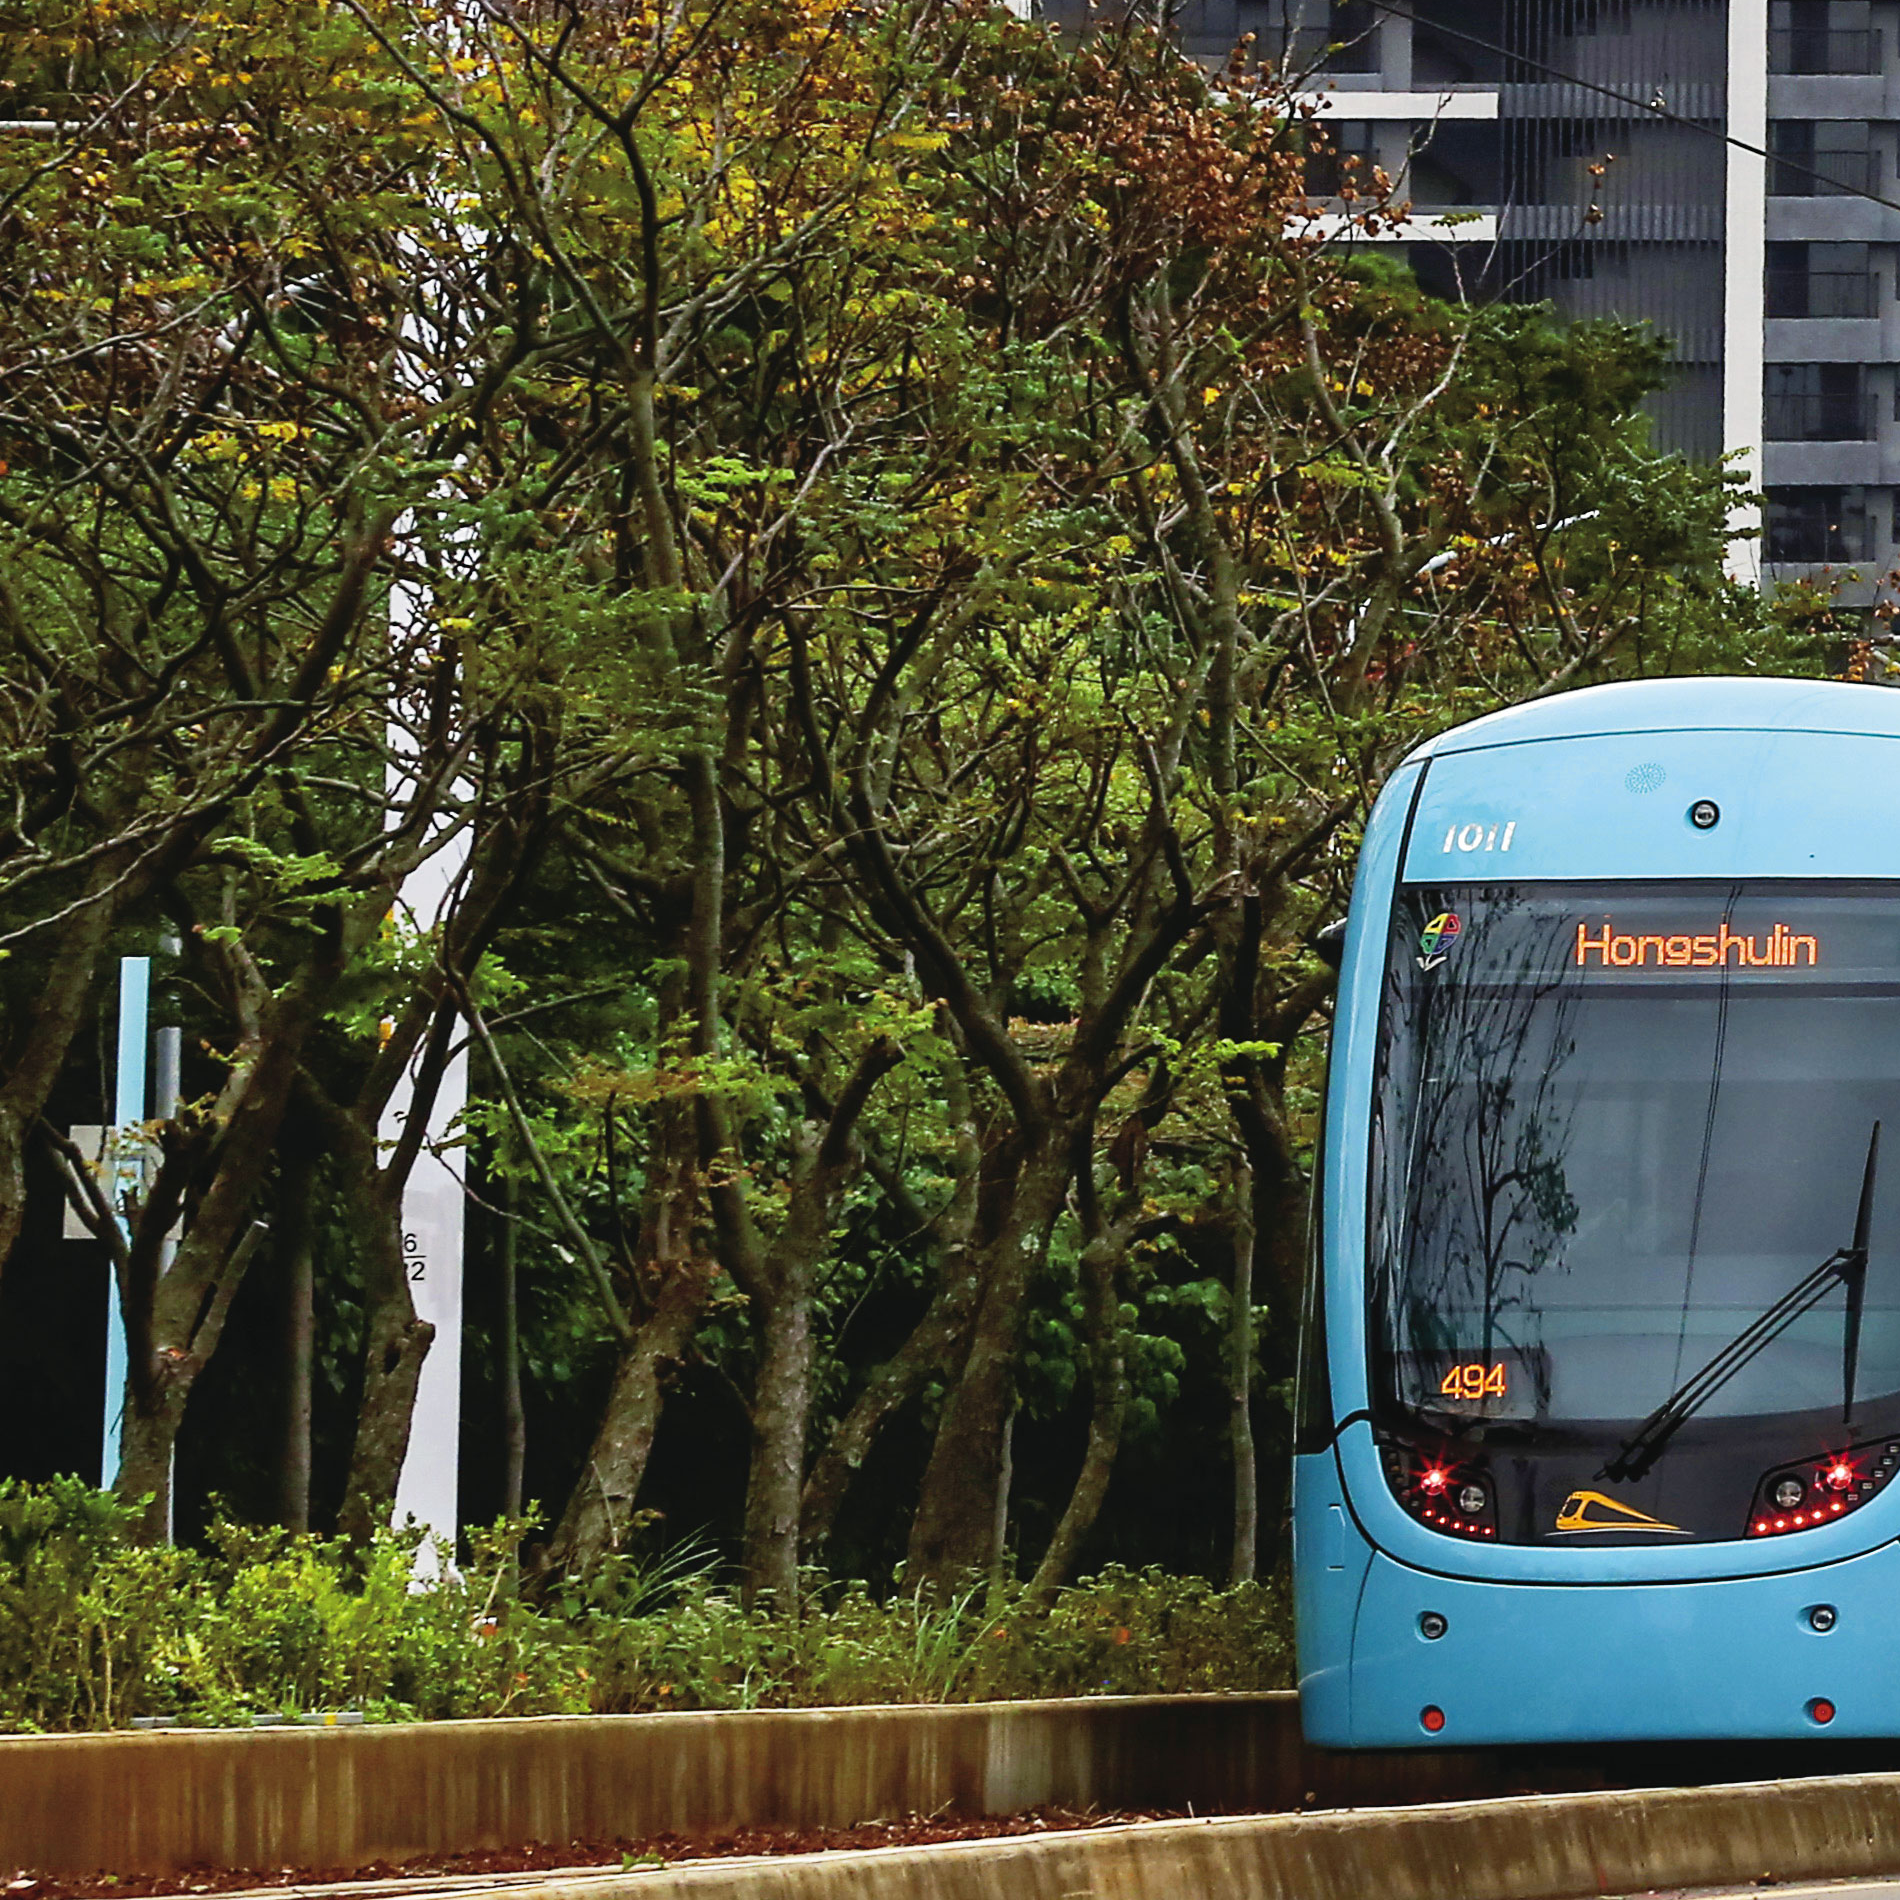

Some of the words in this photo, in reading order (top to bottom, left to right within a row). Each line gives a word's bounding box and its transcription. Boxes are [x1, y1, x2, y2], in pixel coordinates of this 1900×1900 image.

[1442, 820, 1517, 854] 1011
[1576, 922, 1818, 967] Hongshulin
[1441, 1362, 1507, 1400] 494
